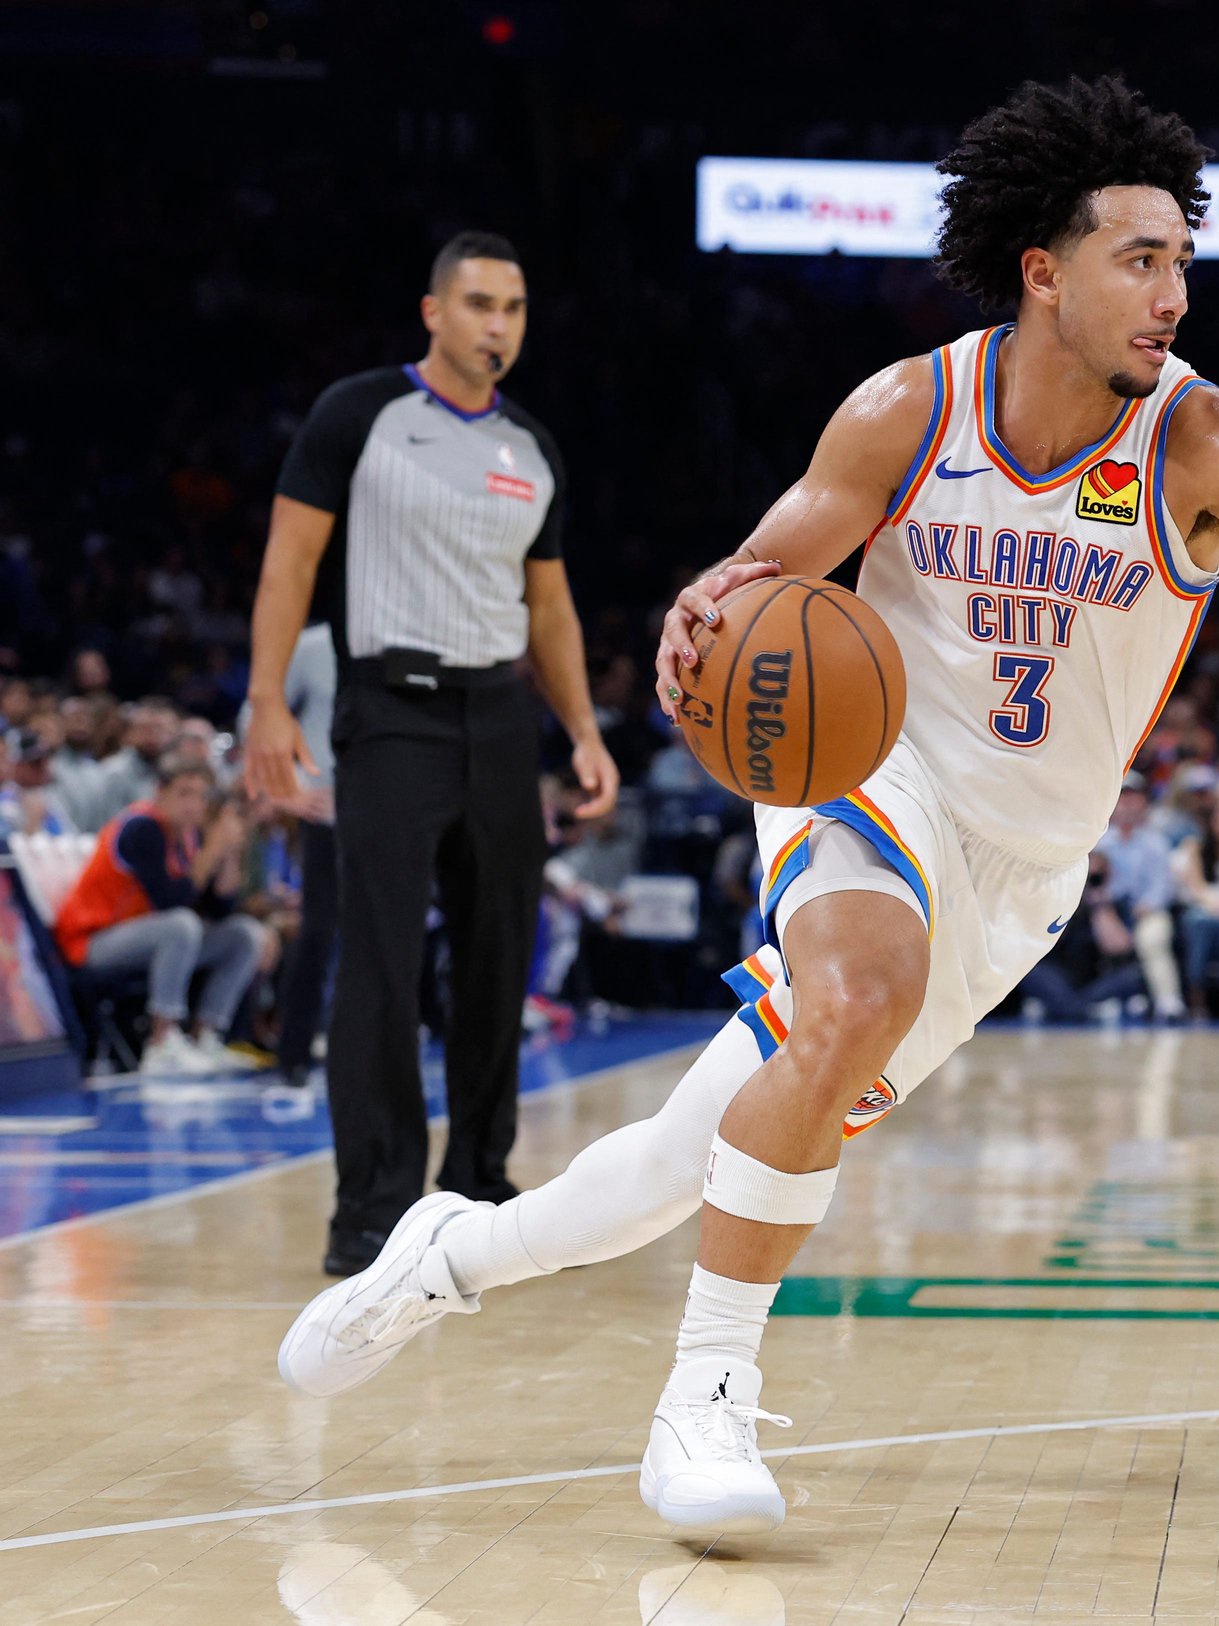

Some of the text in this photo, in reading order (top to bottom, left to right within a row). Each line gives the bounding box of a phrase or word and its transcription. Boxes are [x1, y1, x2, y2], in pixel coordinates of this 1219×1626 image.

[906, 520, 1154, 611] OKLAHOMA
[967, 592, 1077, 648] CITY
[746, 648, 794, 793] Wilson
[989, 652, 1055, 748] 3
